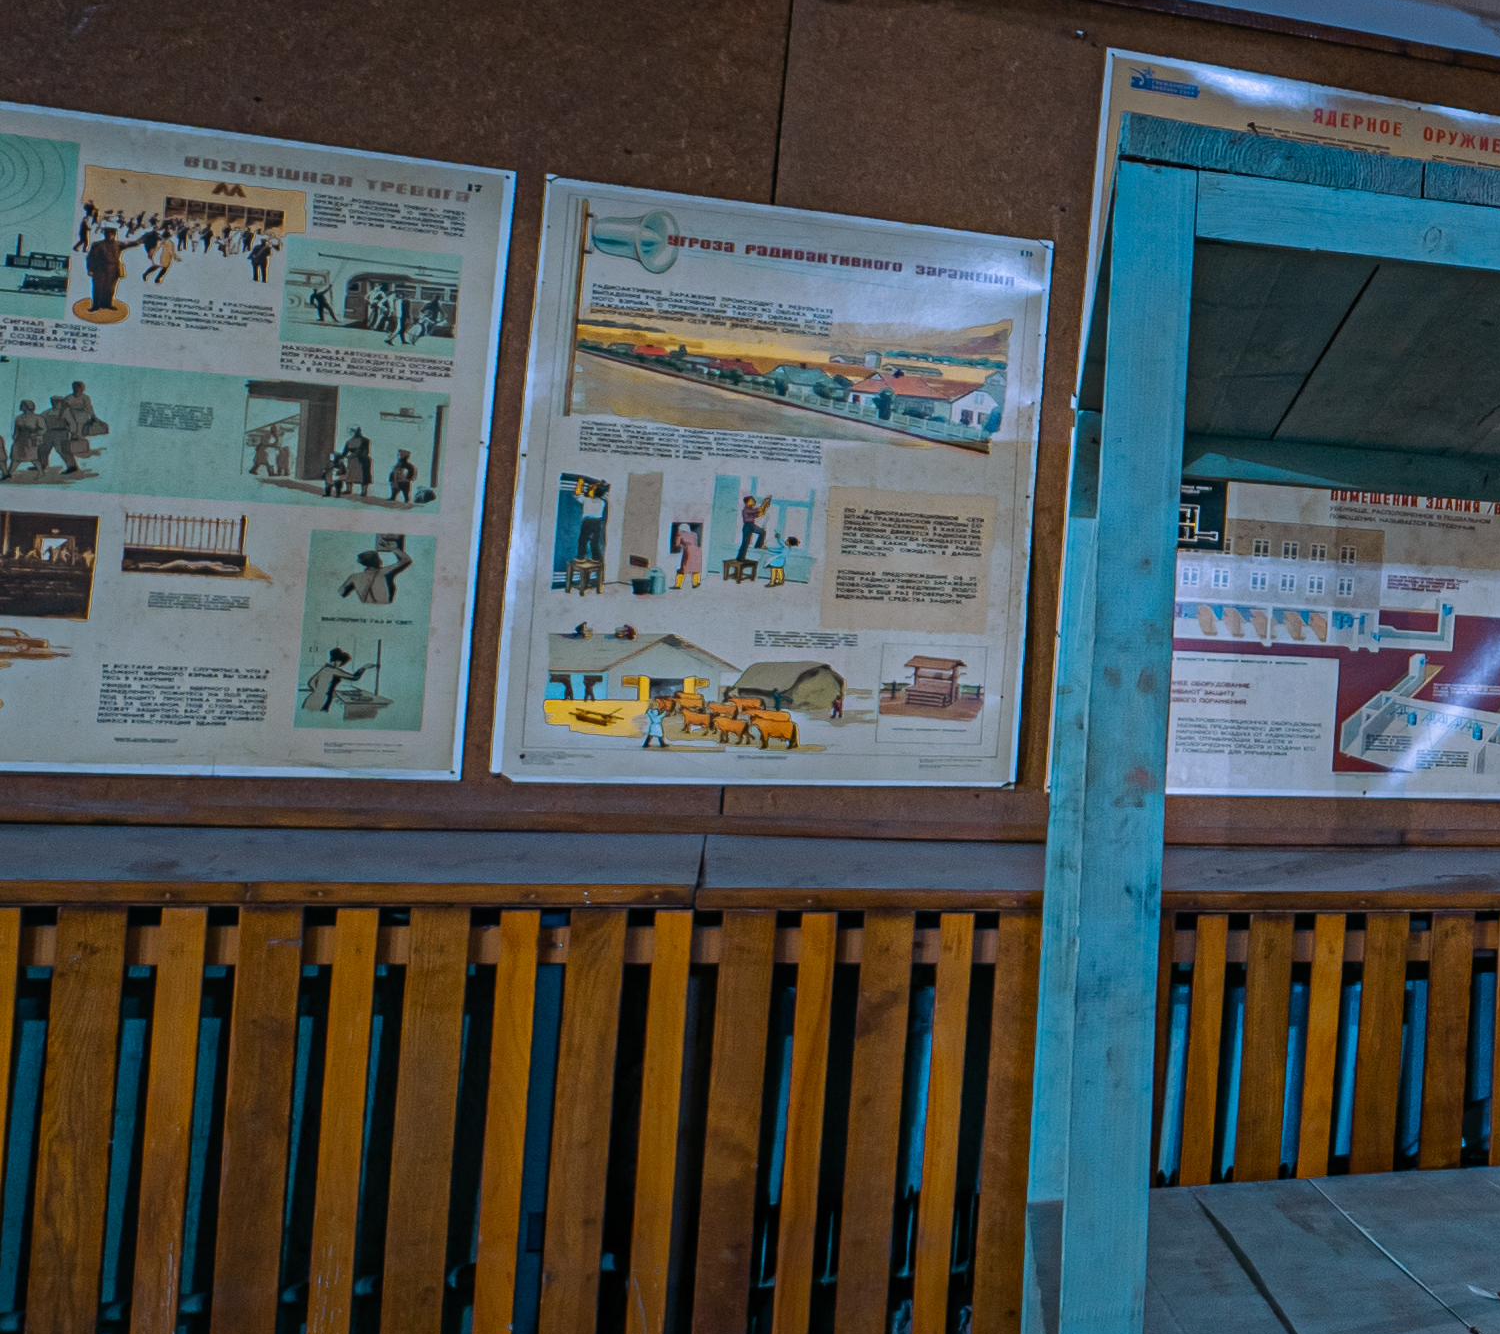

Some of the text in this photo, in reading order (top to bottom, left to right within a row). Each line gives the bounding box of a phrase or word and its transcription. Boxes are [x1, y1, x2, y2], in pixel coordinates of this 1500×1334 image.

[1312, 107, 1402, 138] ЯДЕРНОЕ
[1422, 125, 1500, 154] ОРУЖИЕ
[184, 155, 470, 203] ВОЗДУШНАЯ ТРЕВОГА
[667, 234, 1015, 287] УГРОЗА РАДИОАКТИВНОГО ЗАРАЖЕНИЯ
[1425, 497, 1481, 514] ЗДАНИЯ
